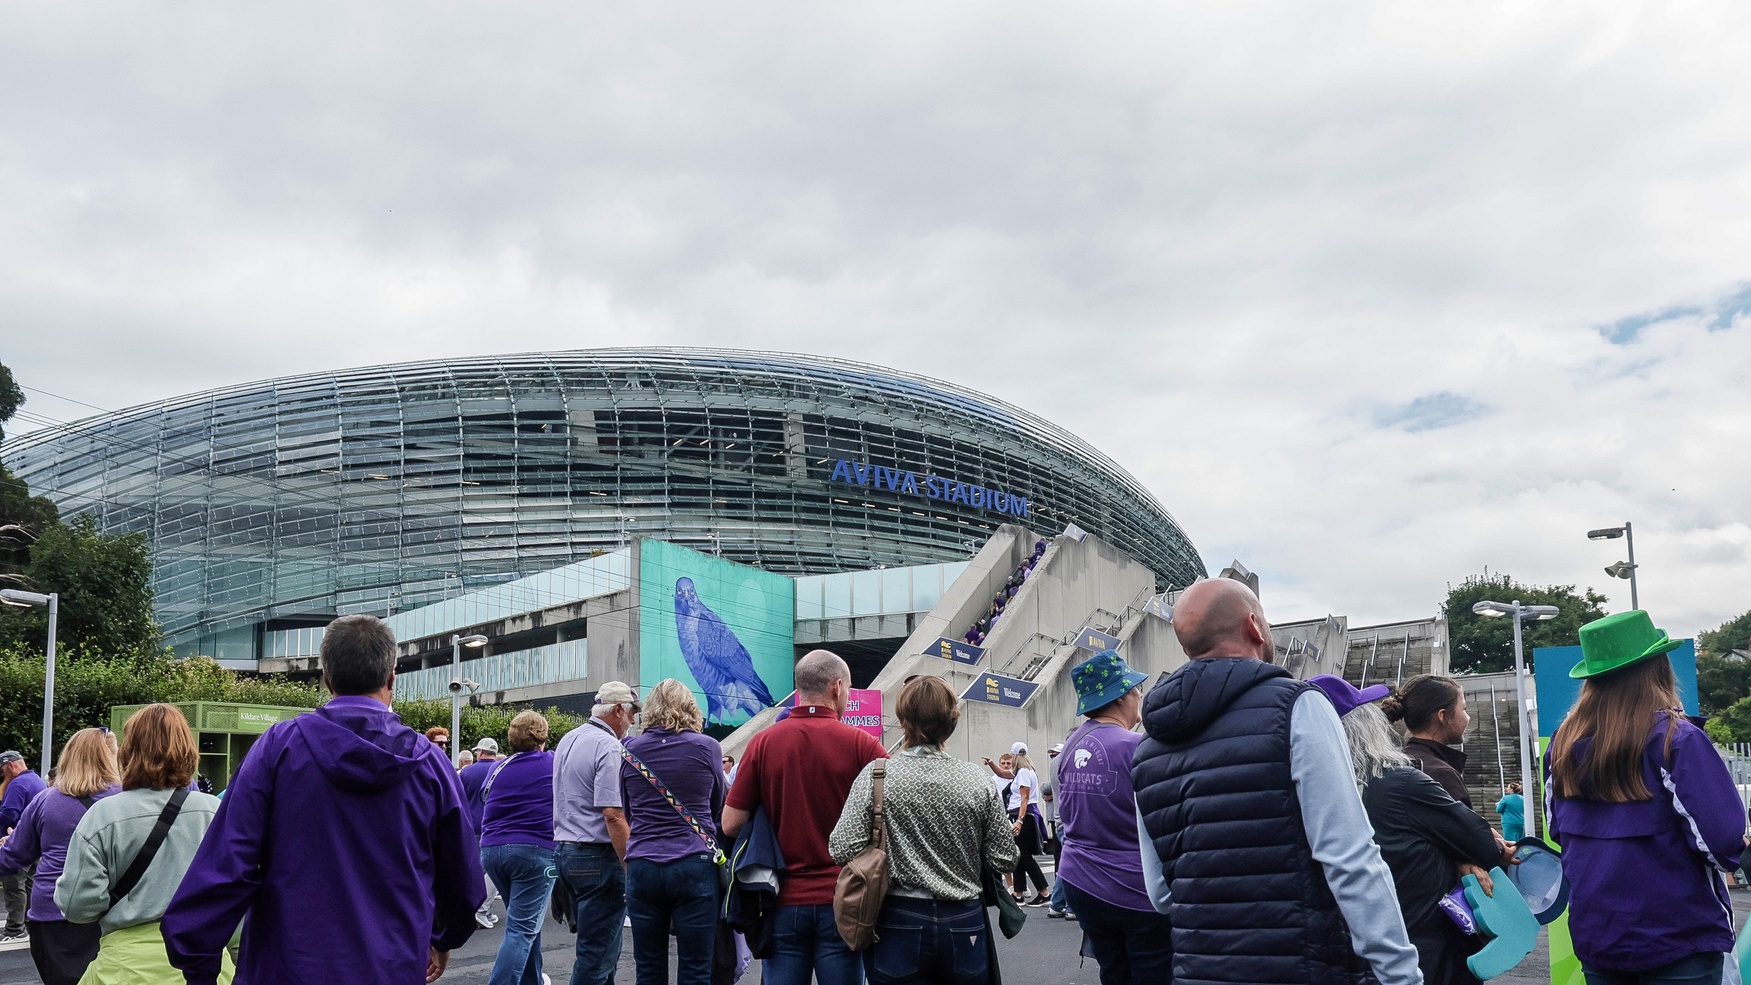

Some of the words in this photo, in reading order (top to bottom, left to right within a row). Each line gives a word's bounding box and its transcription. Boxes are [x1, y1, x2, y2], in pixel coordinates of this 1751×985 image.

[831, 459, 919, 495] AVIVA
[925, 476, 1028, 518] STADIUM
[1003, 687, 1021, 700] Welcome
[260, 713, 278, 722] Village
[1063, 772, 1102, 785] WILDCATS
